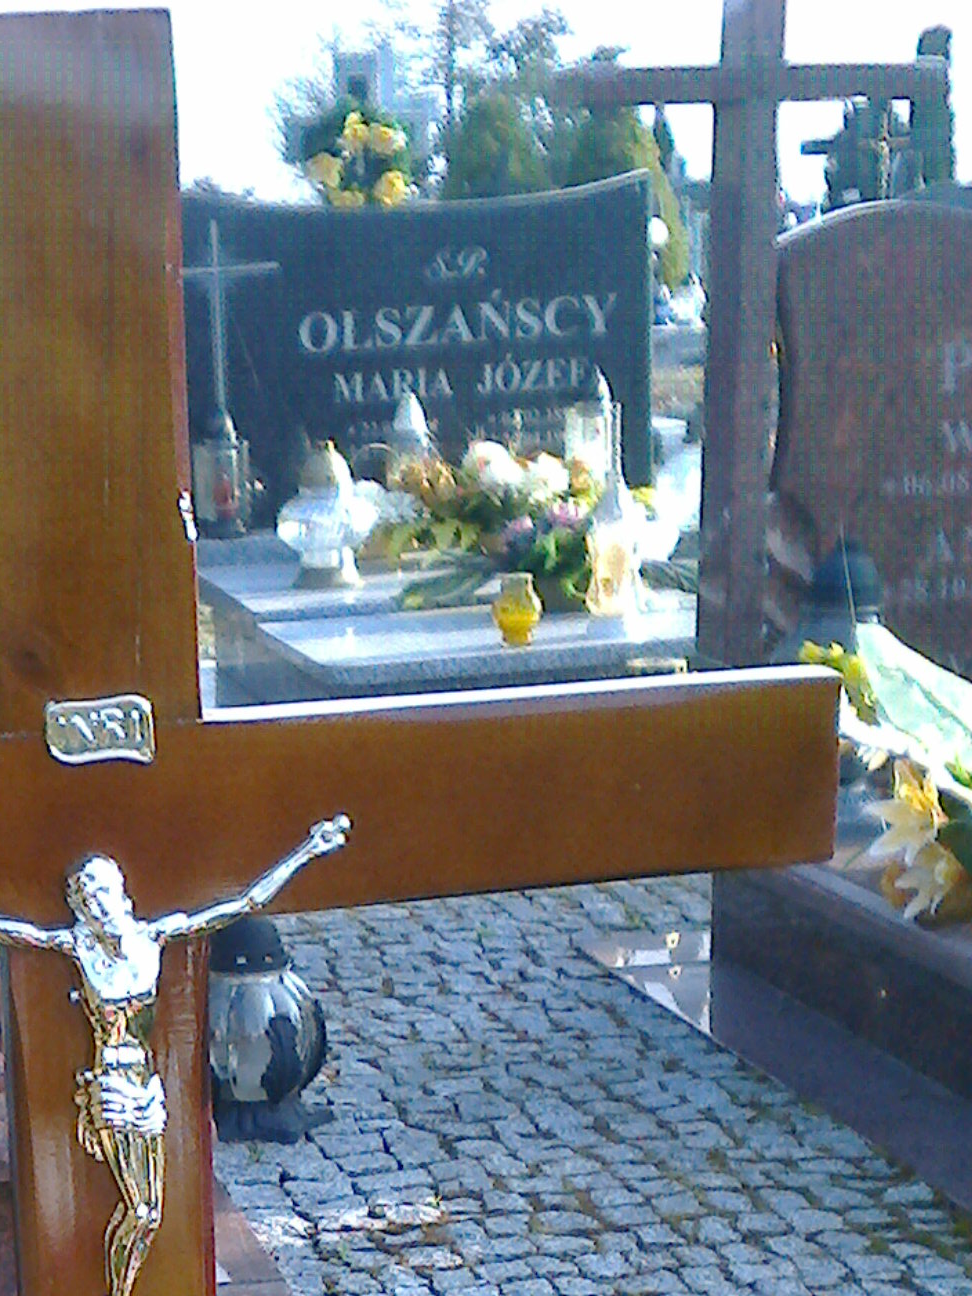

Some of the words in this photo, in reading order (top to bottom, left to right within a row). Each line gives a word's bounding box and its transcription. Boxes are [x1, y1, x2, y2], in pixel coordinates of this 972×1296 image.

[299, 287, 618, 352] OLSZAŃSCY
[332, 367, 454, 402] MARIA
[477, 352, 590, 394] JÓZEF
